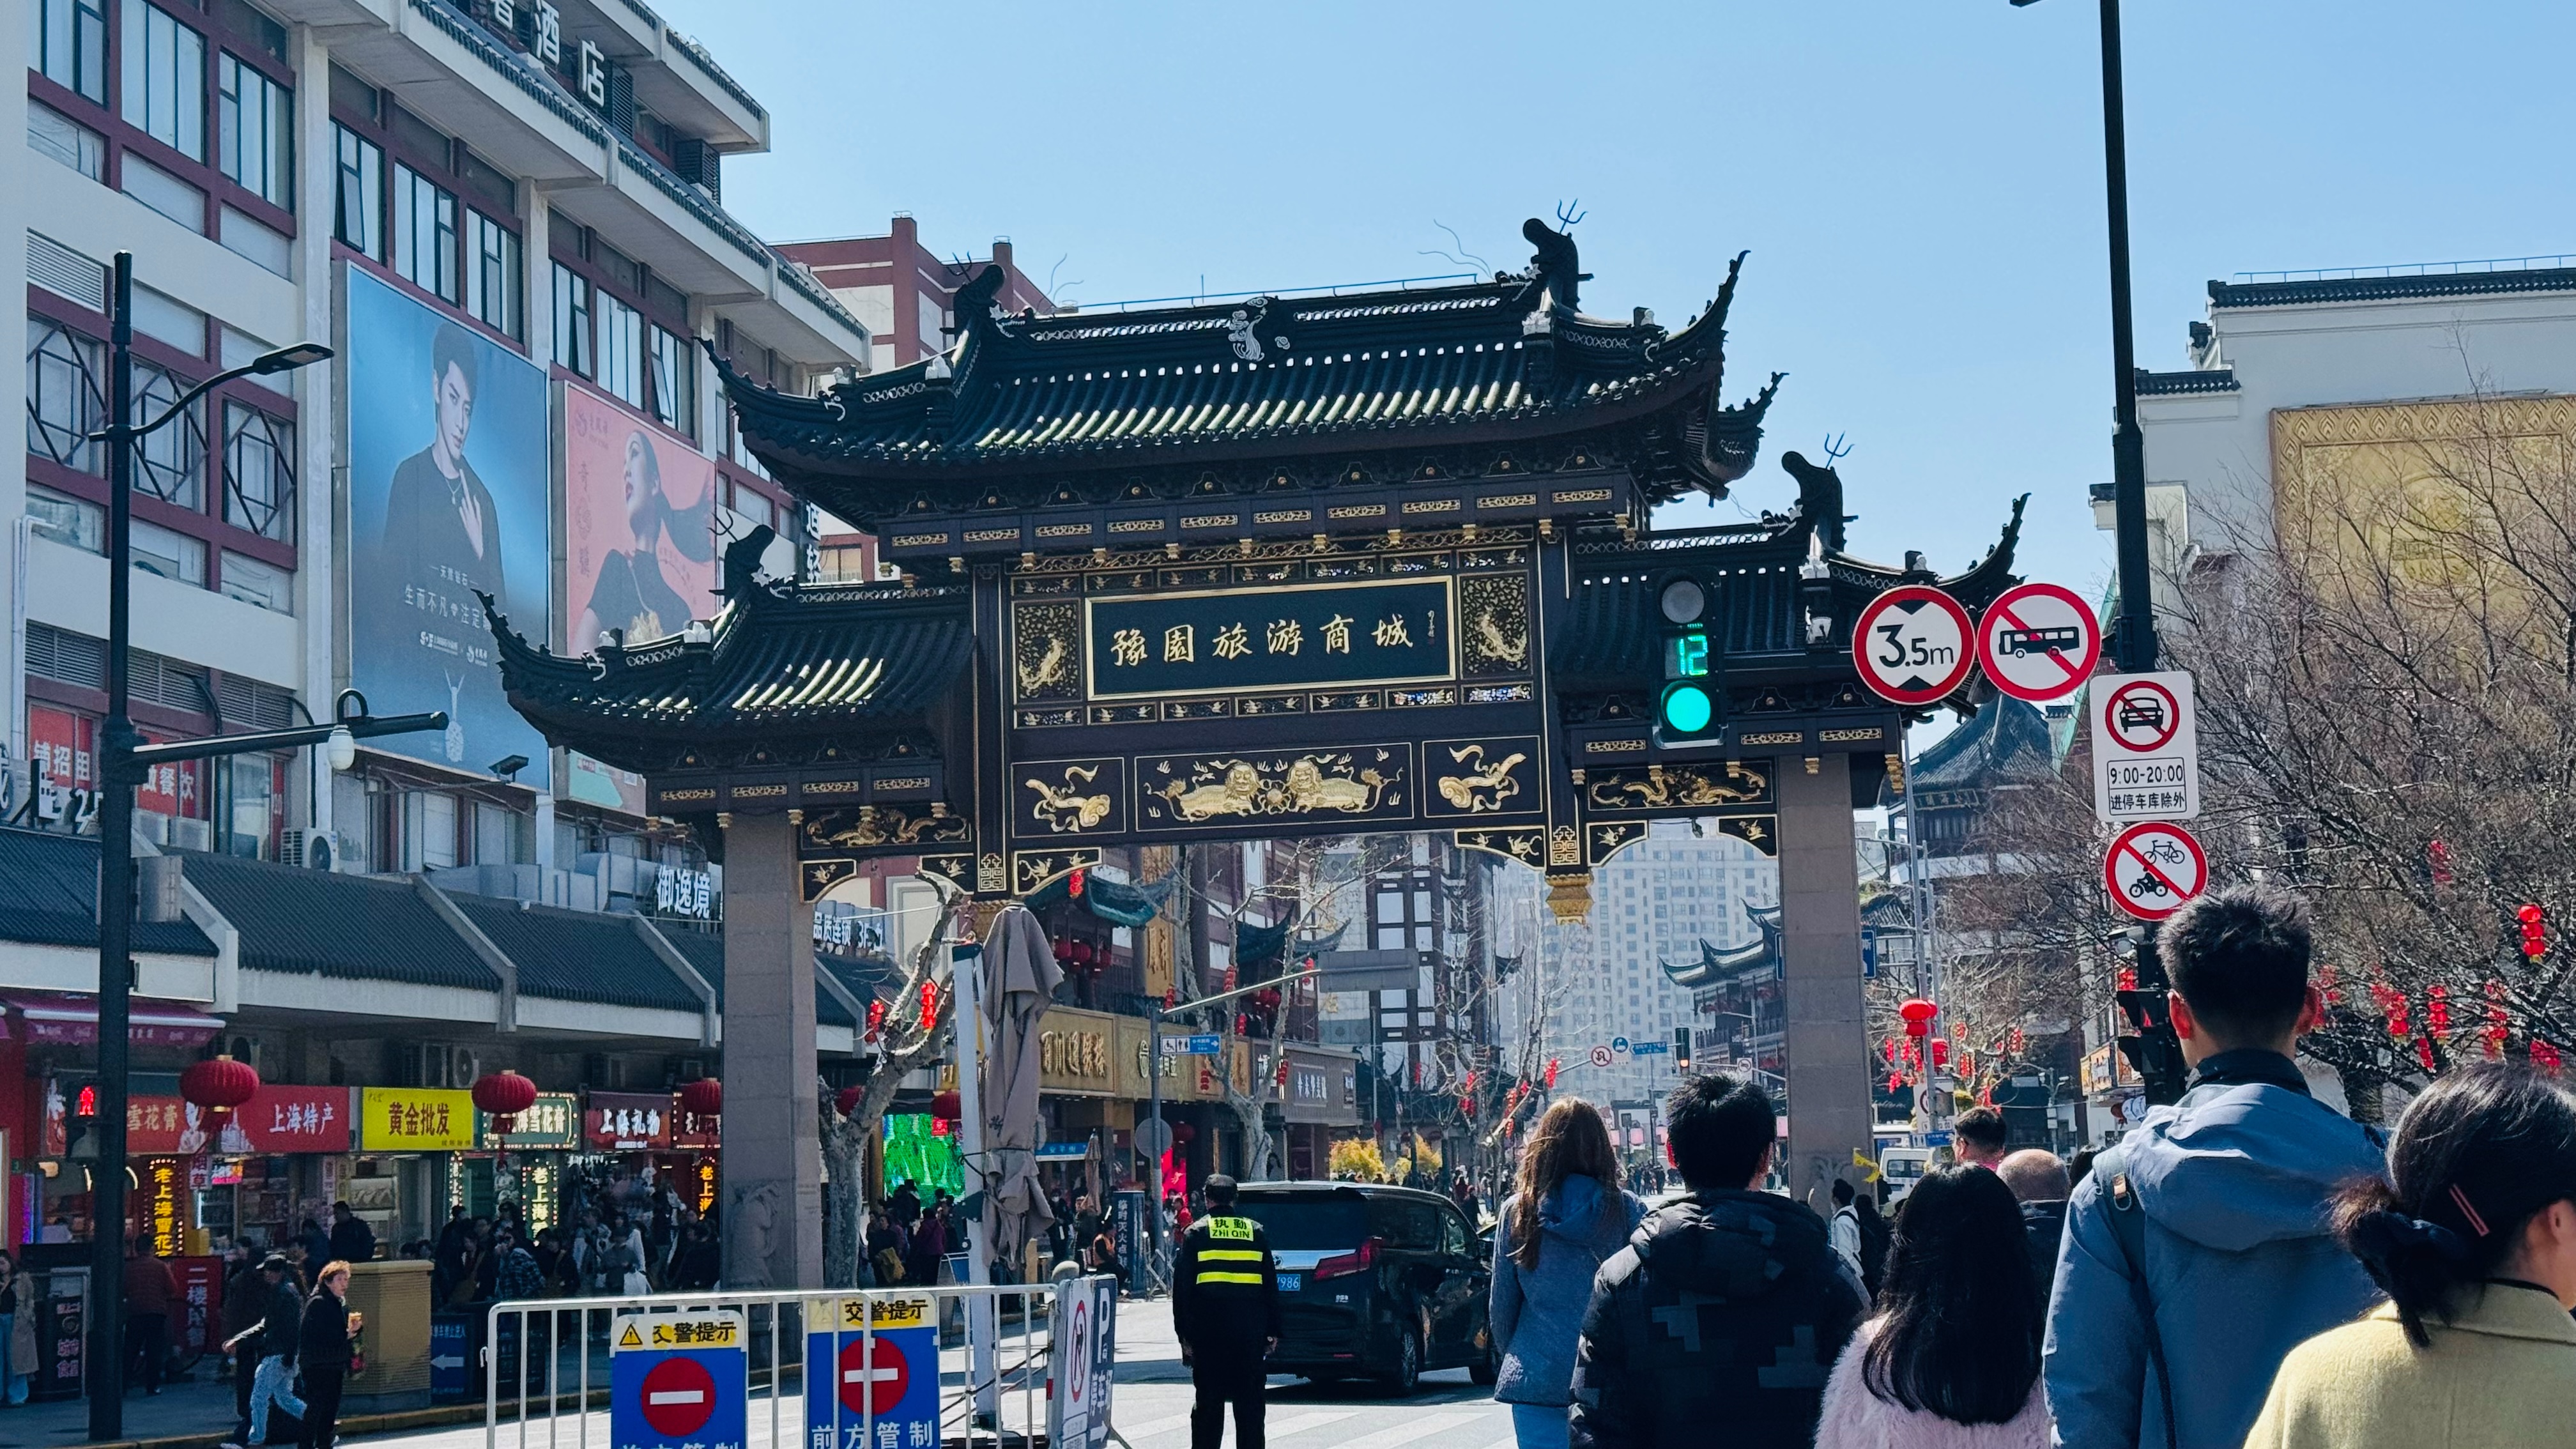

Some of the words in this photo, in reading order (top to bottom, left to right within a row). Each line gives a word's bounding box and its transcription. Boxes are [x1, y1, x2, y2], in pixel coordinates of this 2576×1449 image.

[405, 584, 447, 618] 生而不凡
[1678, 635, 1708, 676] 12
[1876, 624, 1954, 668] 3.5m
[2110, 765, 2183, 784] 9:00-20:00
[2110, 792, 2185, 810] 进停车库除外
[657, 865, 710, 918] 御逸境
[813, 911, 851, 946] 品质连锁
[269, 1102, 334, 1135] 上海特产
[388, 1101, 450, 1135] 黄金批发
[1212, 1229, 1229, 1238] ZHI
[1215, 1218, 1247, 1229] 执勤
[843, 1299, 929, 1322] 交警提示
[811, 1420, 933, 1449] 前方管制
